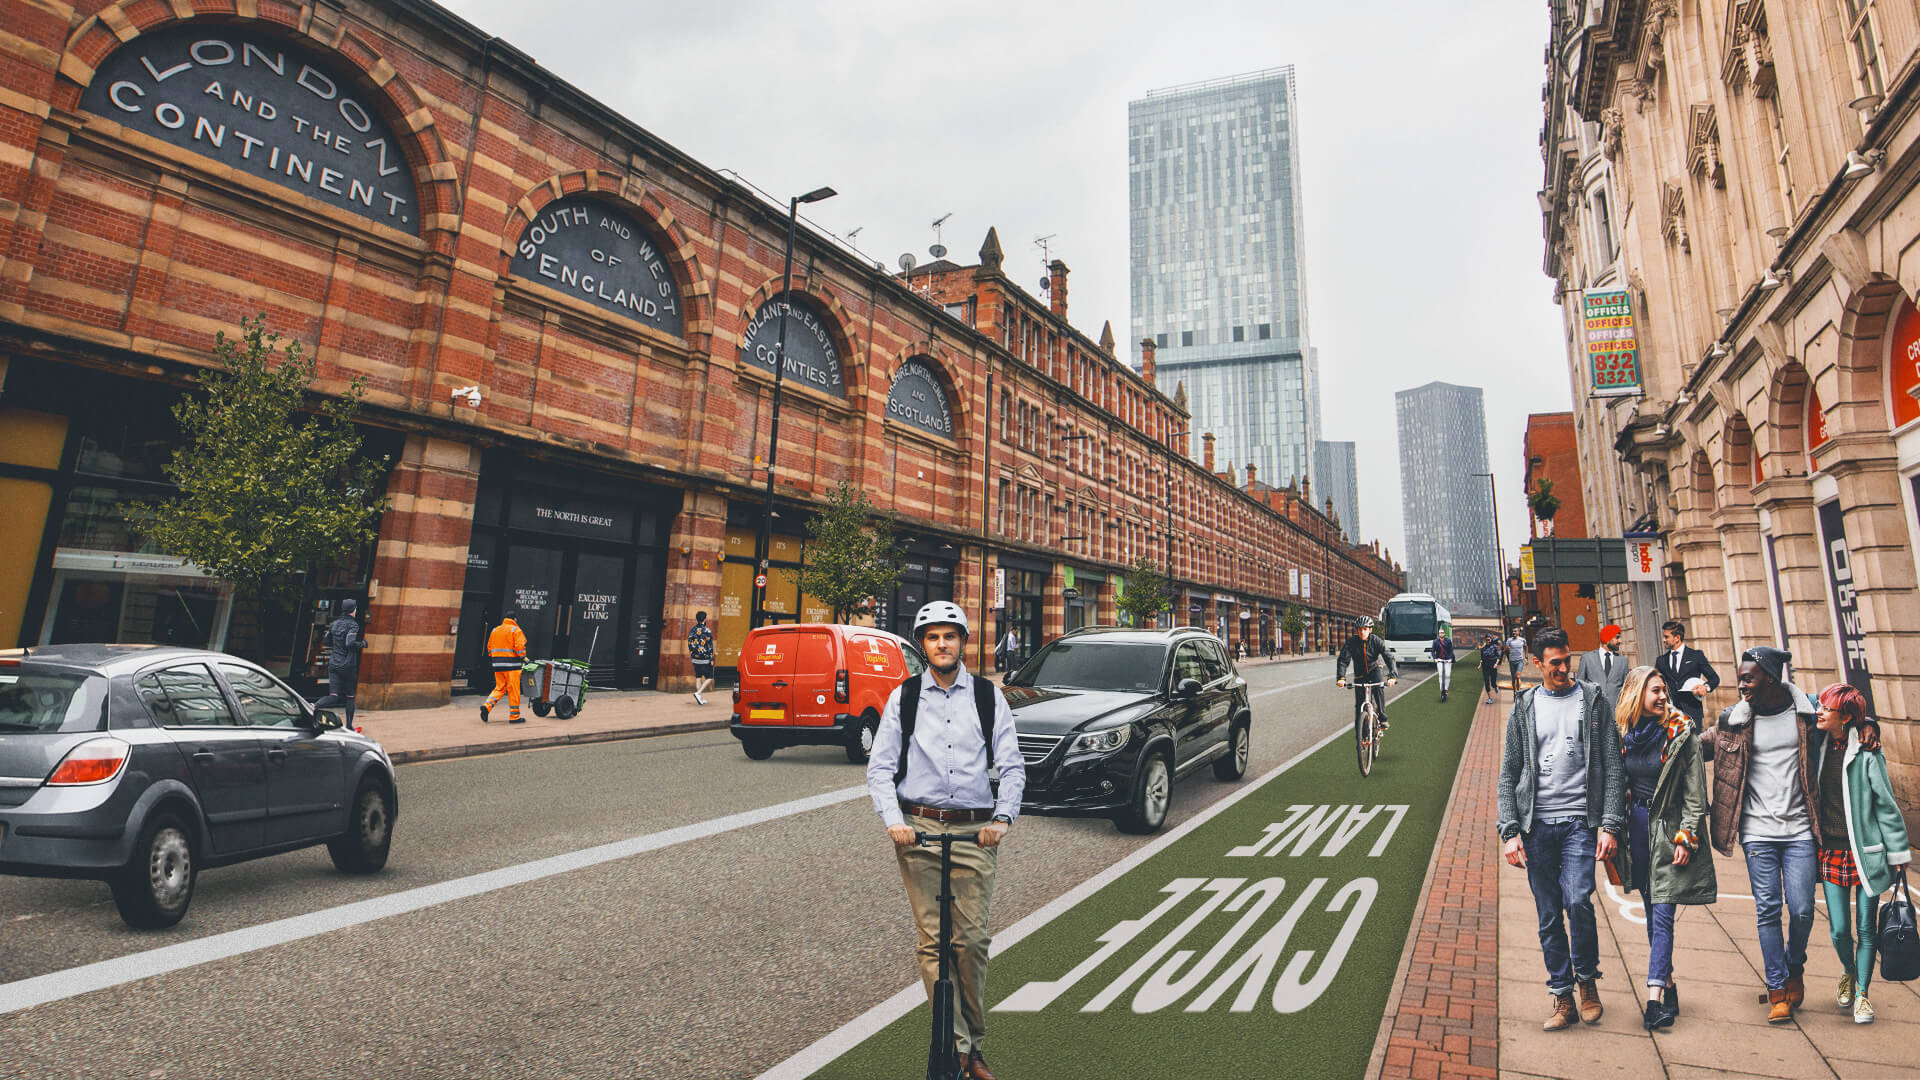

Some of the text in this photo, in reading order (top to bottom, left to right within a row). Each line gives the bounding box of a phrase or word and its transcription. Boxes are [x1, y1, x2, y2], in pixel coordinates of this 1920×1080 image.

[140, 39, 399, 177] LONDON
[204, 81, 351, 154] AND THE
[109, 80, 408, 223] CONTINENT.
[519, 207, 676, 316] SOUTH AND WEST
[591, 249, 622, 267] OF
[538, 253, 661, 322] ENGLAND.
[1588, 295, 1625, 306] TO LET
[1586, 305, 1630, 317] OFFICES
[1588, 317, 1631, 329] OFFICES
[1589, 328, 1633, 340] OFFICES
[787, 307, 803, 321] AND
[804, 312, 840, 385] EASTERN
[1590, 340, 1634, 352] OFFICES
[1594, 352, 1634, 371] 832
[1596, 369, 1636, 385] 8321
[536, 507, 613, 527] THE NORTH IS GREAT
[1639, 542, 1653, 573] hobs
[756, 577, 766, 585] 20
[578, 593, 617, 604] EXCLUSIVE
[587, 602, 608, 611] LOFT
[583, 610, 609, 620] LIVING
[1224, 804, 1410, 857] LANE
[988, 876, 1379, 1014] CYCLE
